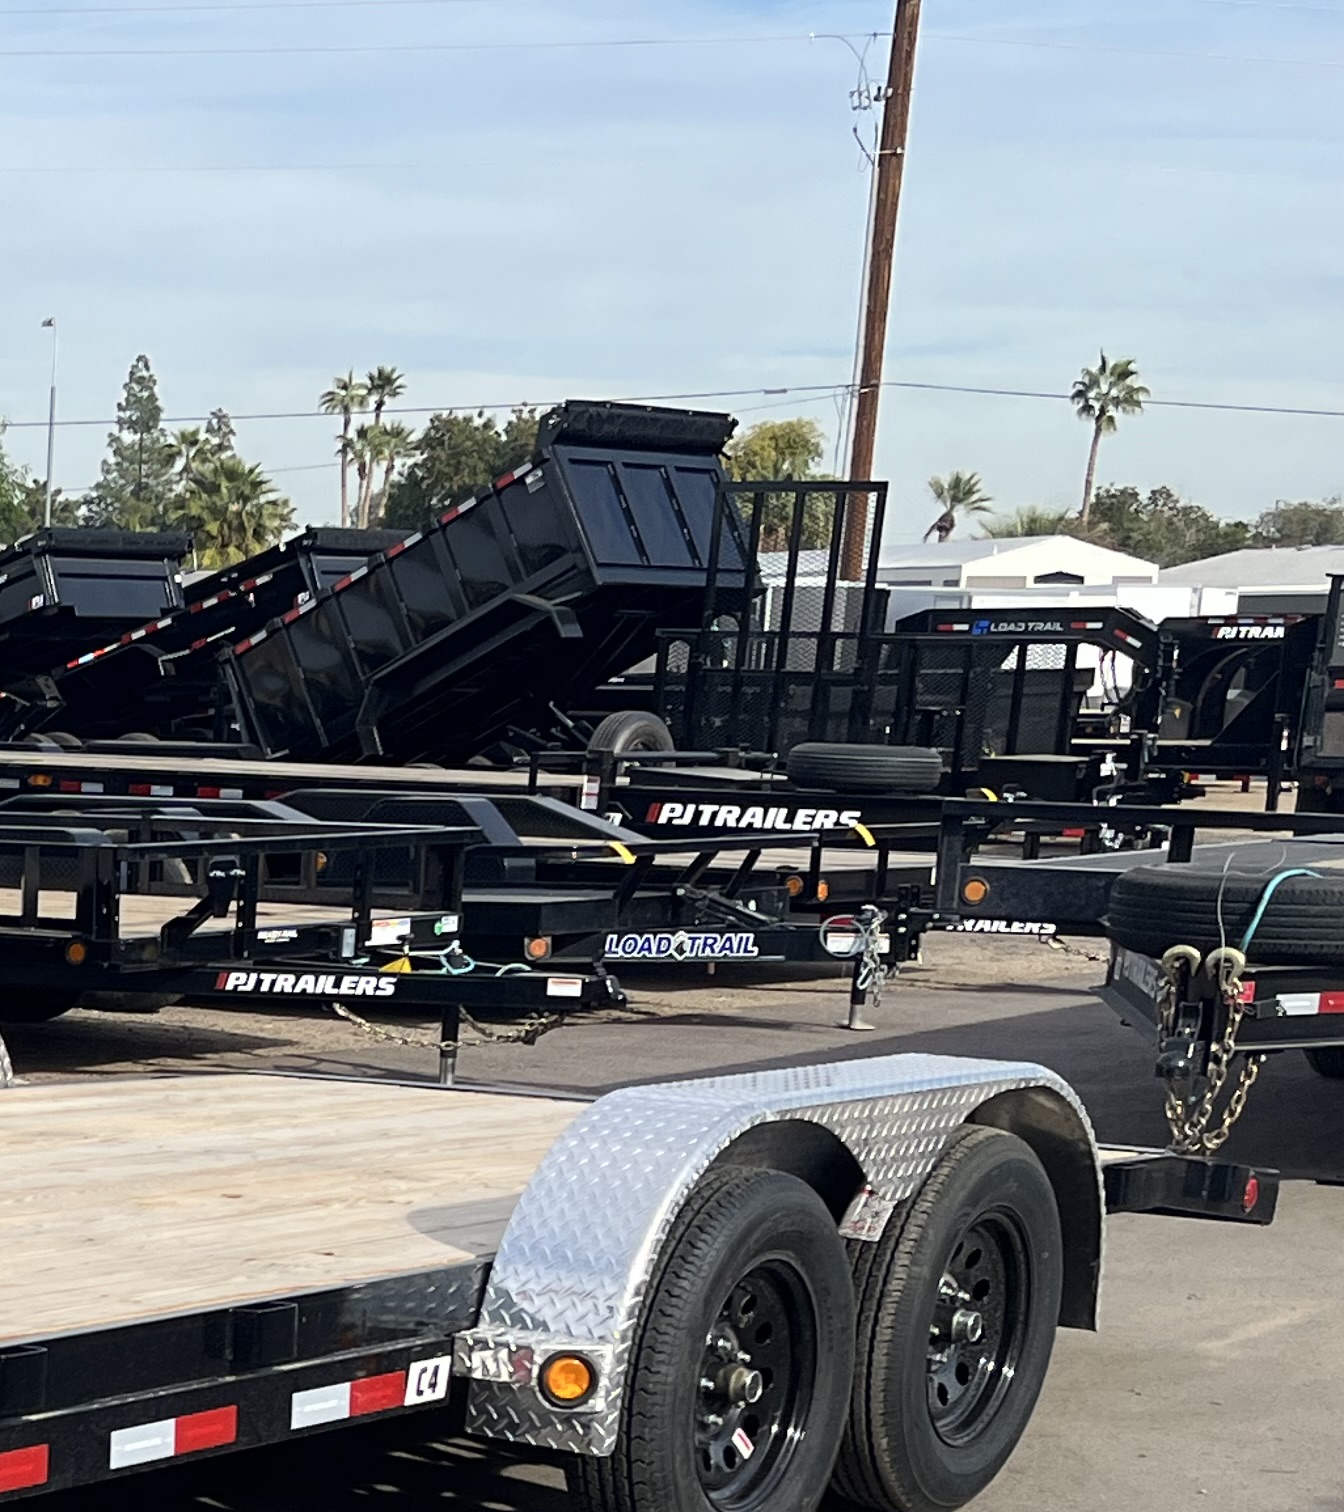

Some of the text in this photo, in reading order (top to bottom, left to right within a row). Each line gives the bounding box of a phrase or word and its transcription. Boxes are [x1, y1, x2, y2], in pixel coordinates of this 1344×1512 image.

[990, 622, 1025, 632] LOAD
[1027, 621, 1064, 632] TRAIL
[1216, 626, 1285, 639] PJ TRAI
[657, 803, 862, 831] PJ TRAILERS
[604, 932, 760, 959] LOAD TRAIL
[225, 972, 398, 997] PJ TRAILERS
[415, 1363, 441, 1397] C4
